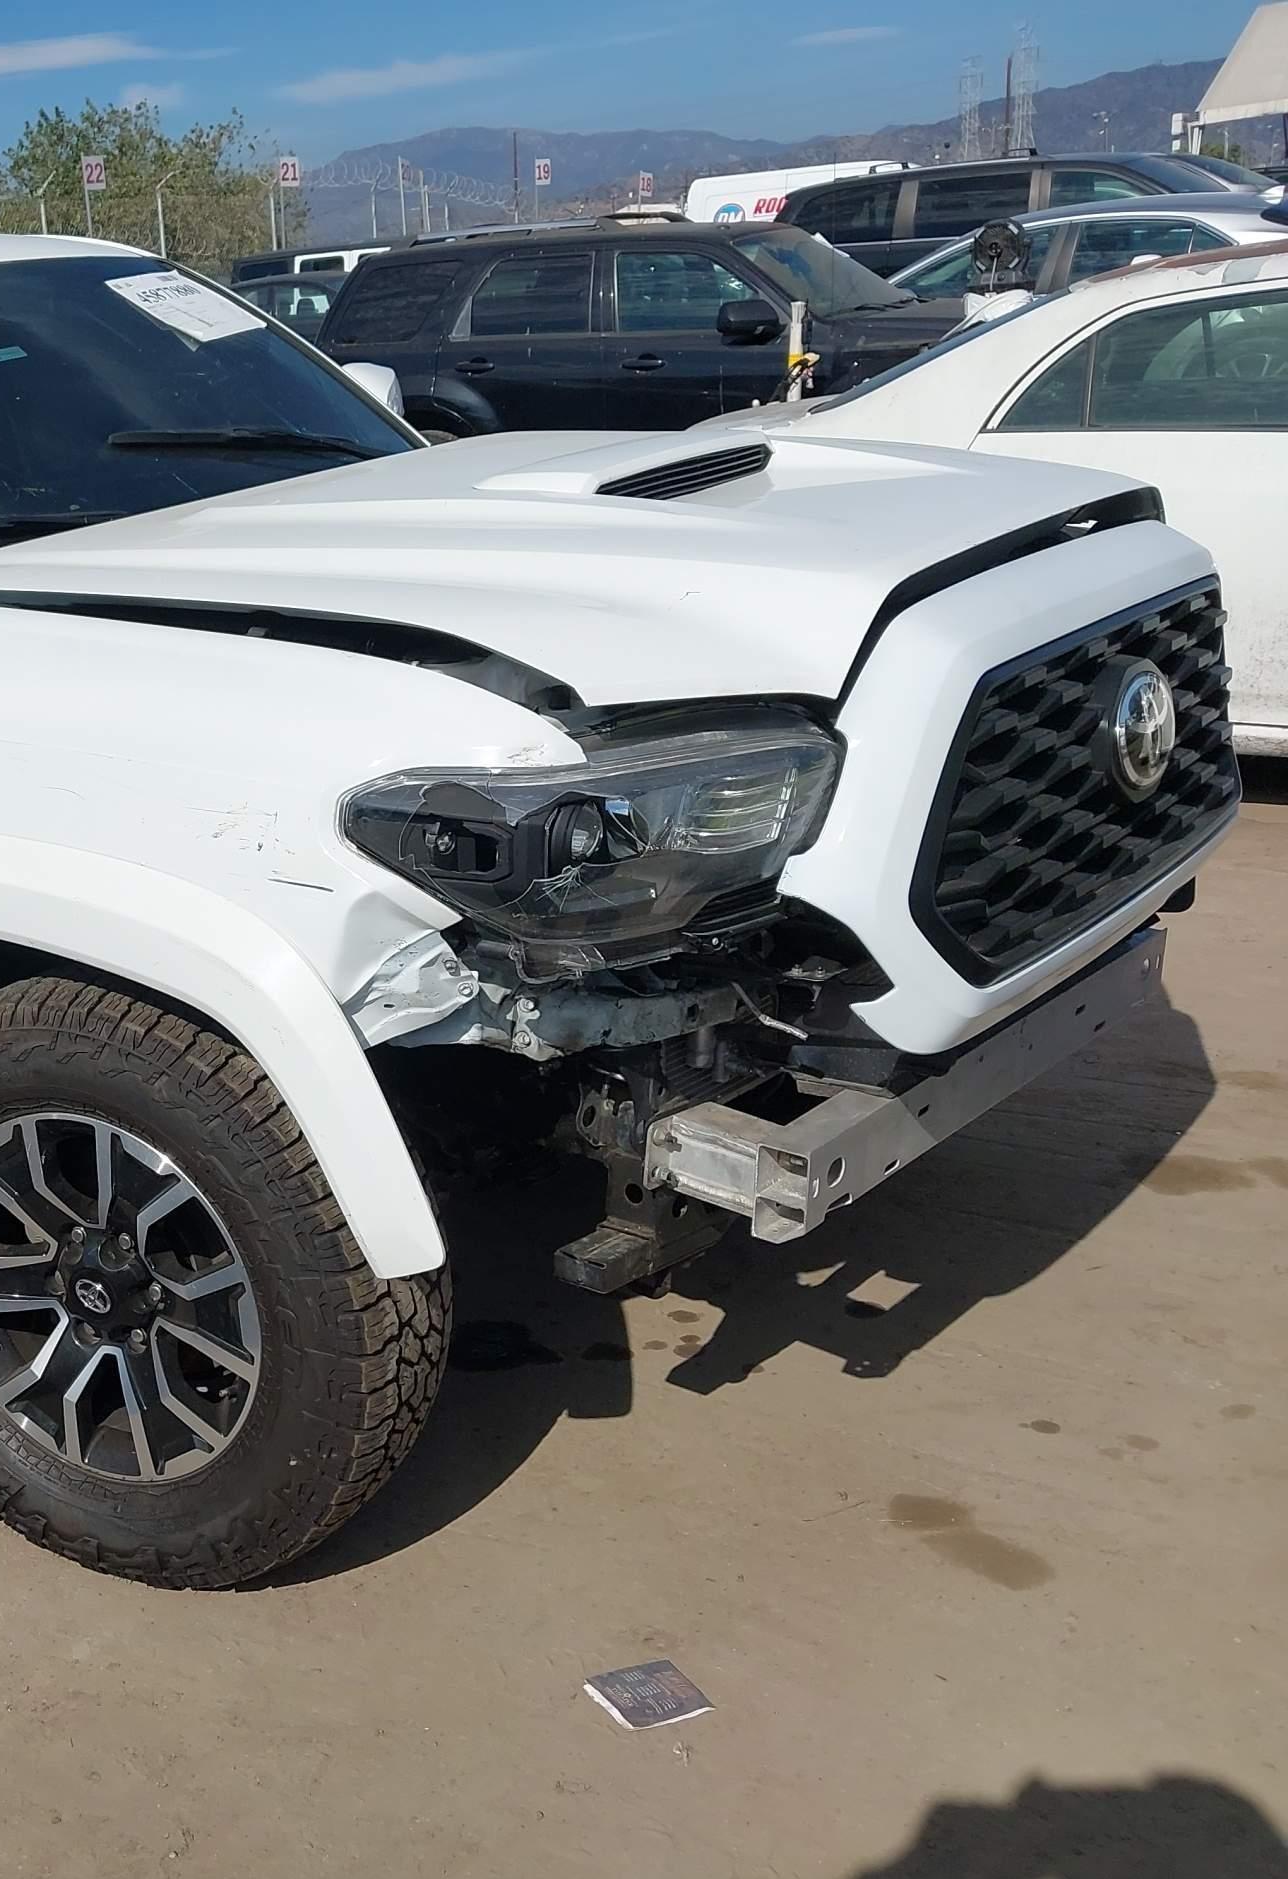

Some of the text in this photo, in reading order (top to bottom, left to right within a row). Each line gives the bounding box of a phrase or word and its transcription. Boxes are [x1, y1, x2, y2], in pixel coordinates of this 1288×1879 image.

[85, 163, 105, 184] 22
[281, 162, 298, 181] 21
[536, 164, 550, 180] 19
[641, 177, 652, 193] 18
